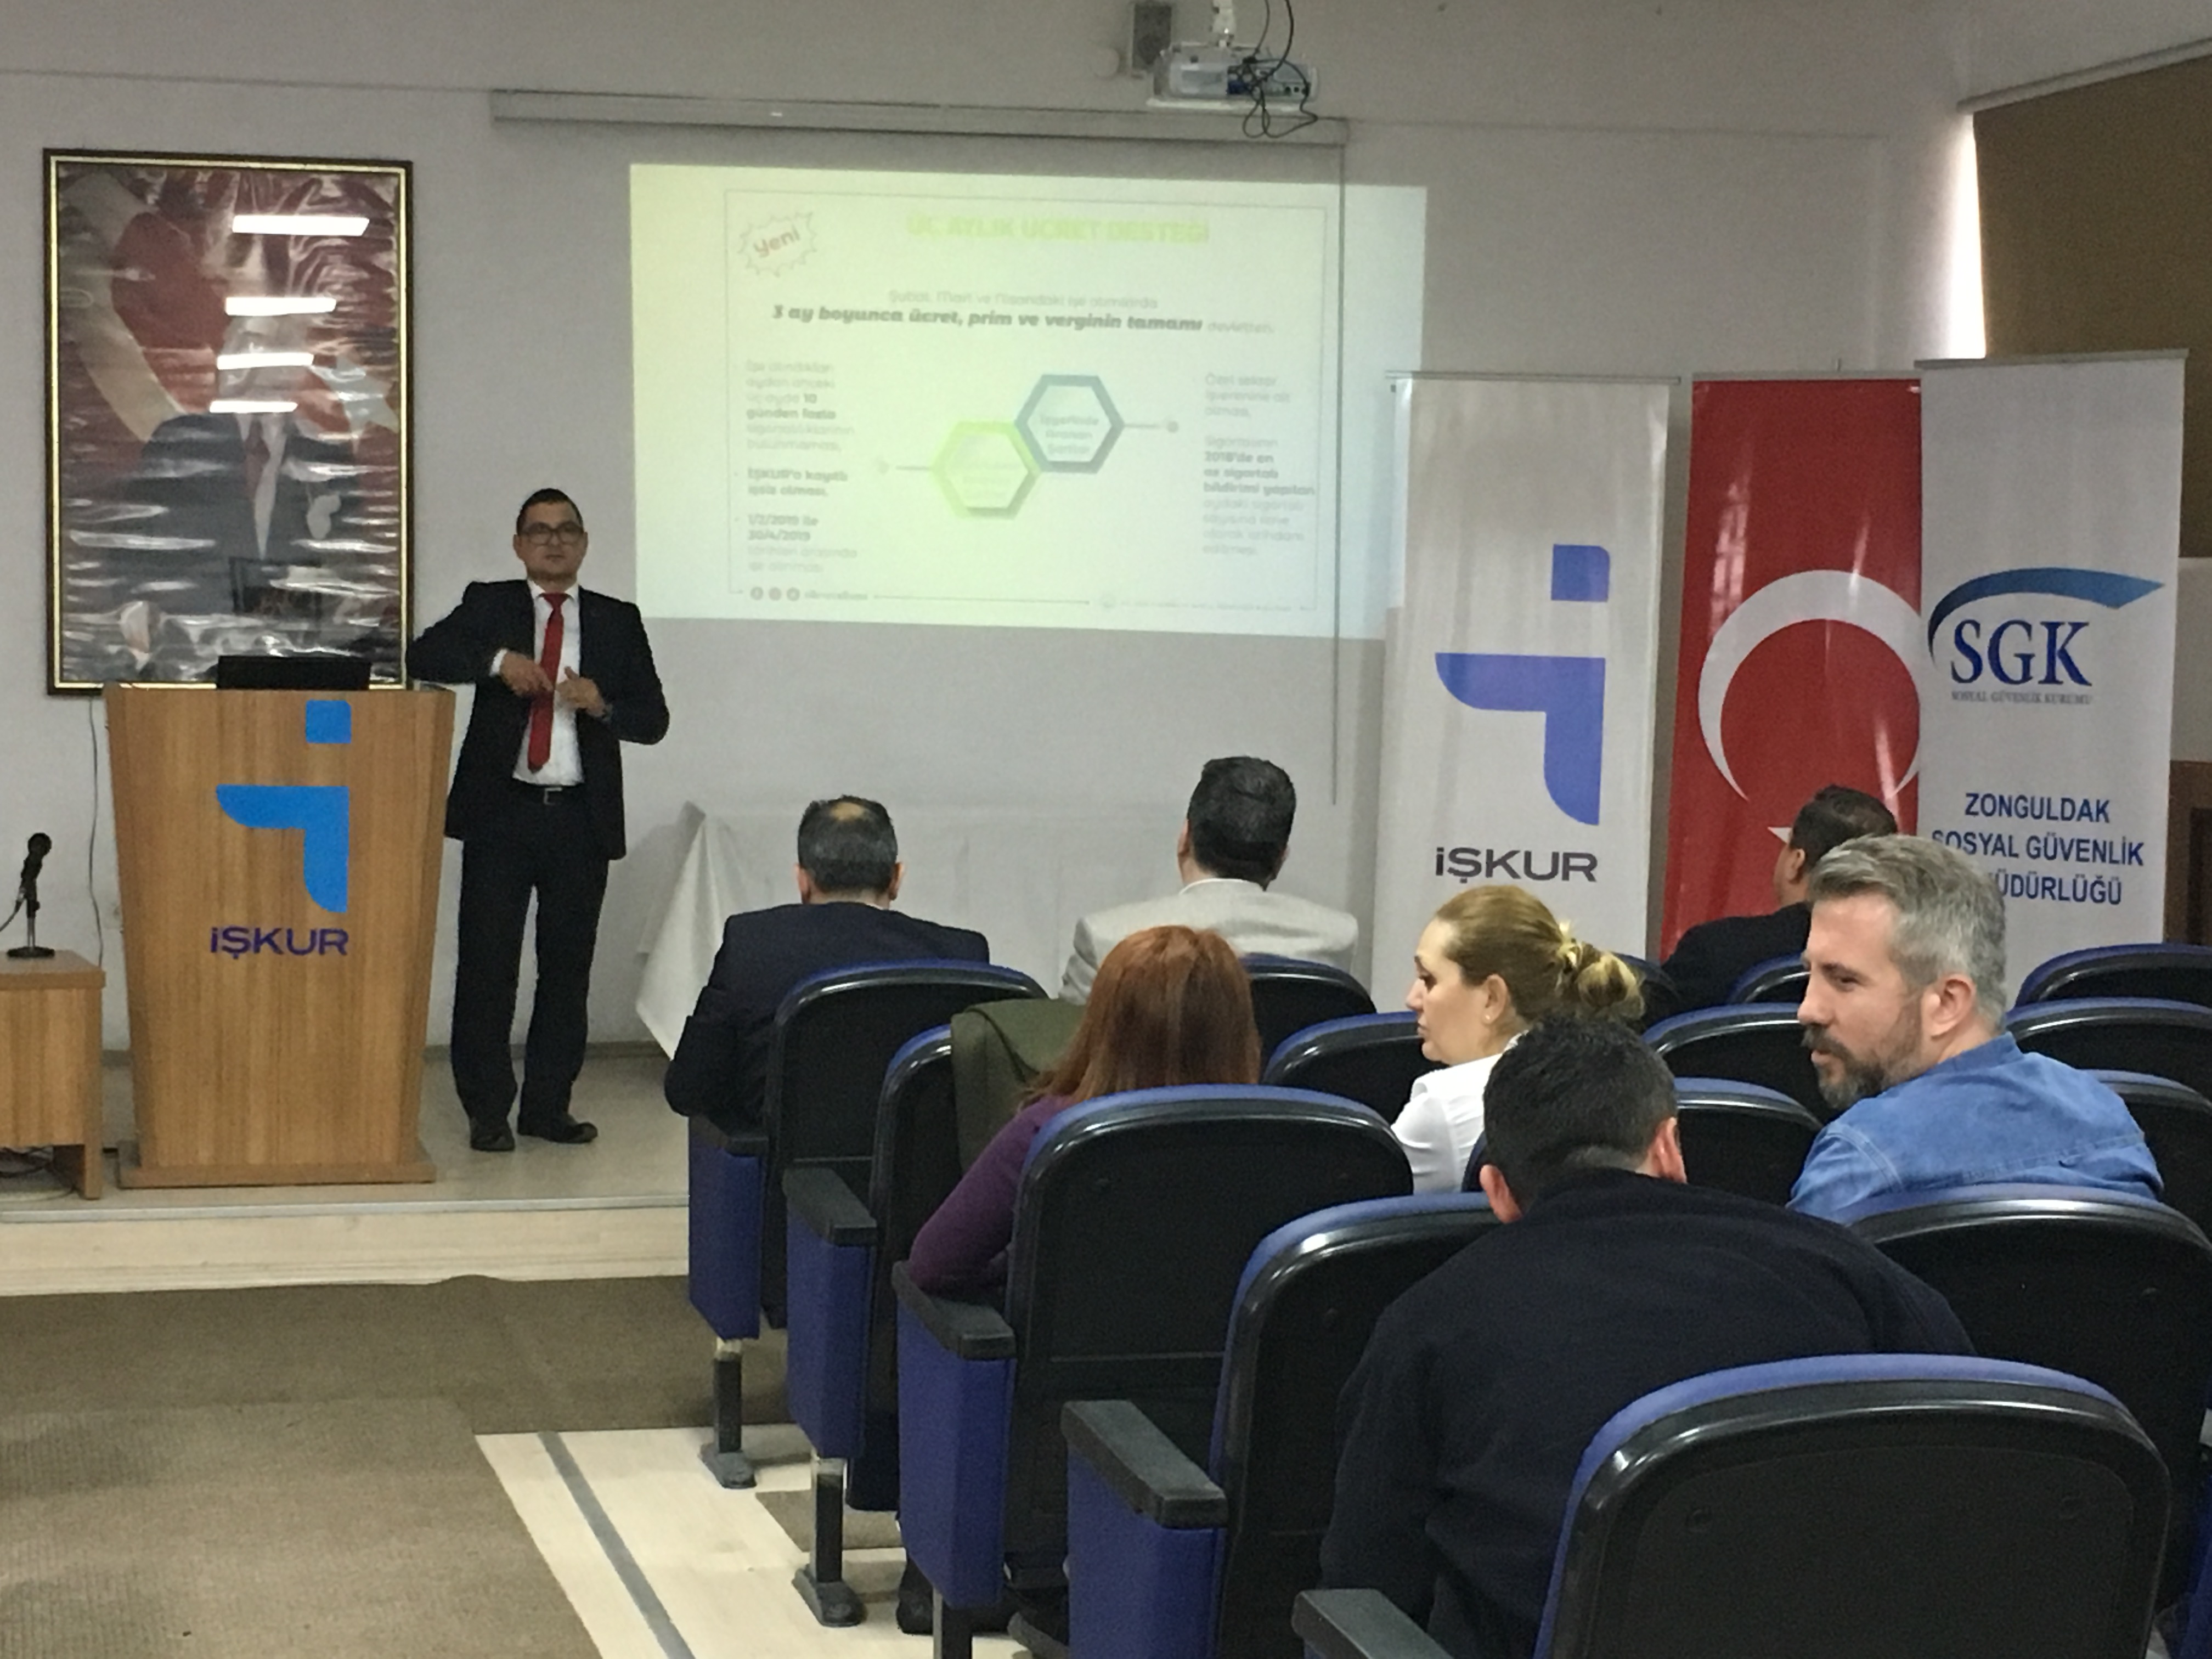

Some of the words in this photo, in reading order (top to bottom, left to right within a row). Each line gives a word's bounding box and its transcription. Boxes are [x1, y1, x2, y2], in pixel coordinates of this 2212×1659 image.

[772, 304, 783, 319] 3
[788, 307, 814, 323] ay
[818, 306, 903, 324] boyunca
[909, 308, 964, 326] ücret,
[967, 309, 1013, 328] prim
[1018, 314, 1040, 326] ve
[1045, 312, 1122, 331] verginin
[1127, 315, 1203, 331] tamamı
[1951, 619, 2092, 686] SGK
[1951, 690, 1988, 703] SOSYAL
[1965, 793, 2111, 823] ZONGULDAK
[2026, 832, 2145, 866] GÜVENLİK
[1989, 868, 2122, 905] ÜDÜRLÜĞÜ
